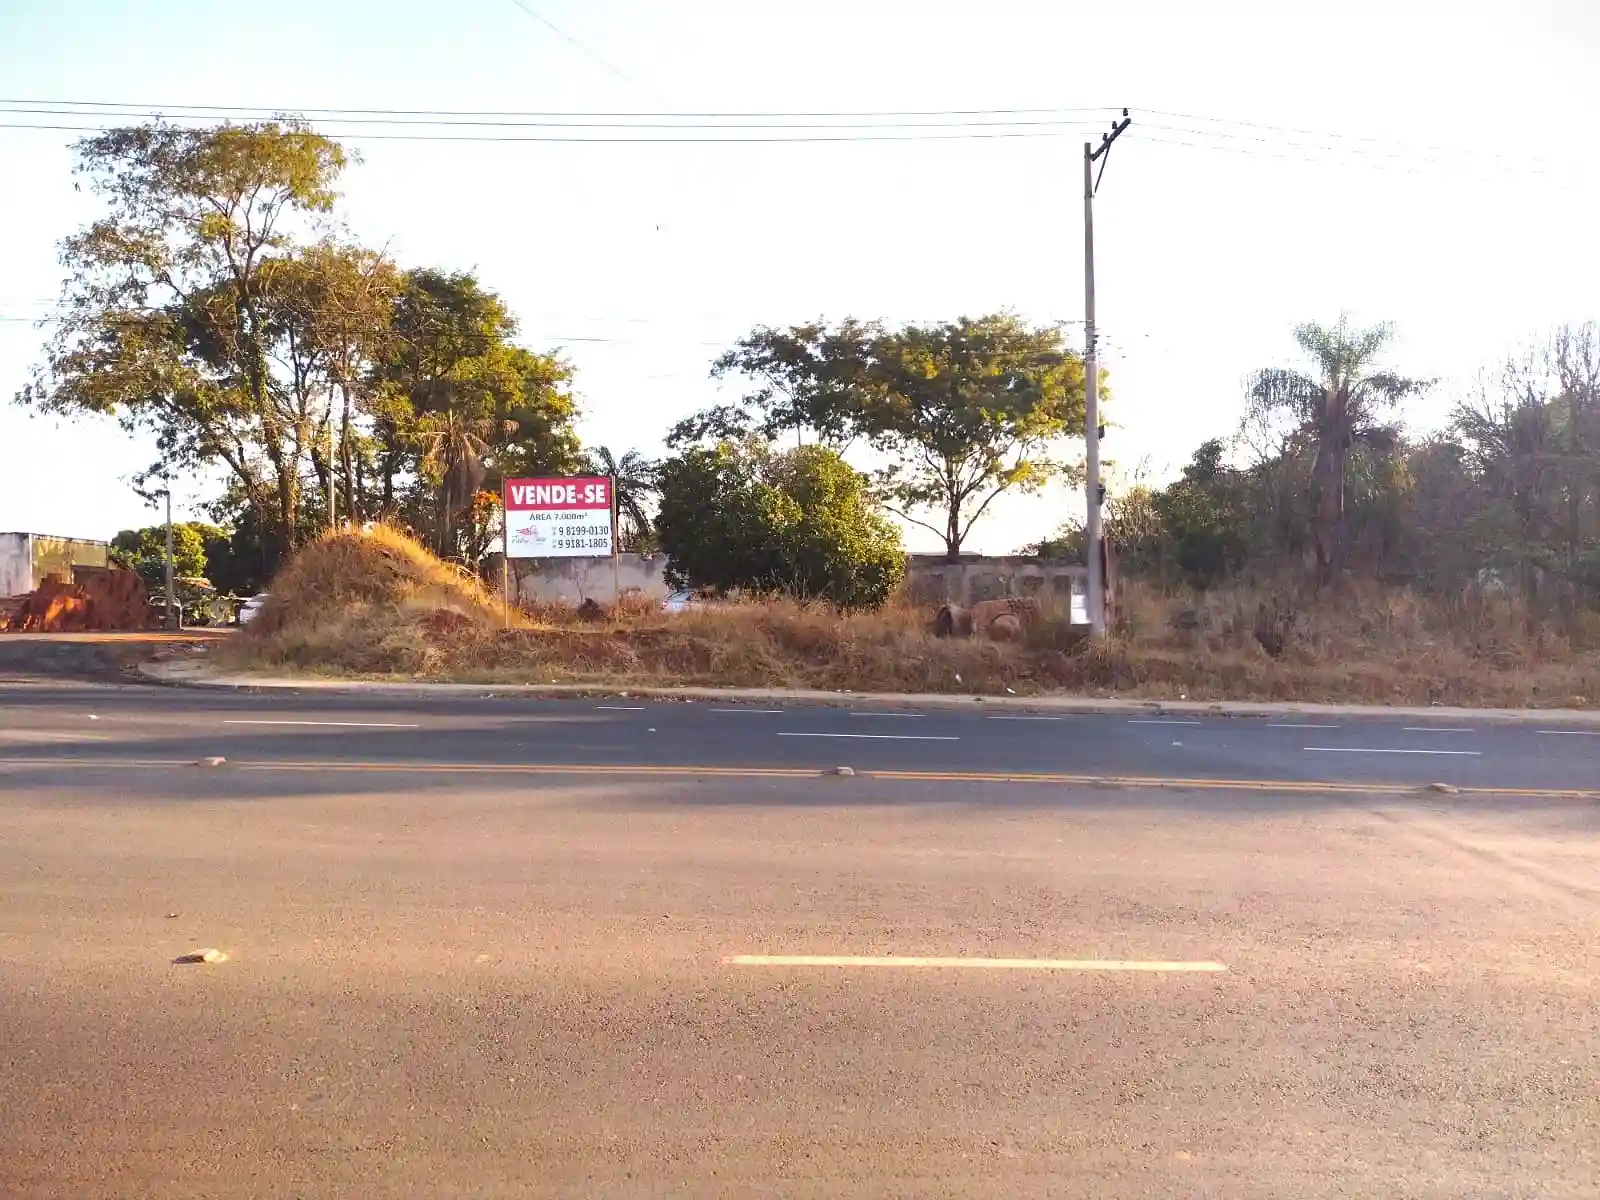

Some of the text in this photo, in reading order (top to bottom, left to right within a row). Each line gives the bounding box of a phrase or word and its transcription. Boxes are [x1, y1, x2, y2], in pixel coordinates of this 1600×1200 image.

[511, 484, 606, 505] VENDE-SE
[558, 526, 564, 536] 9
[558, 539, 564, 549] 9
